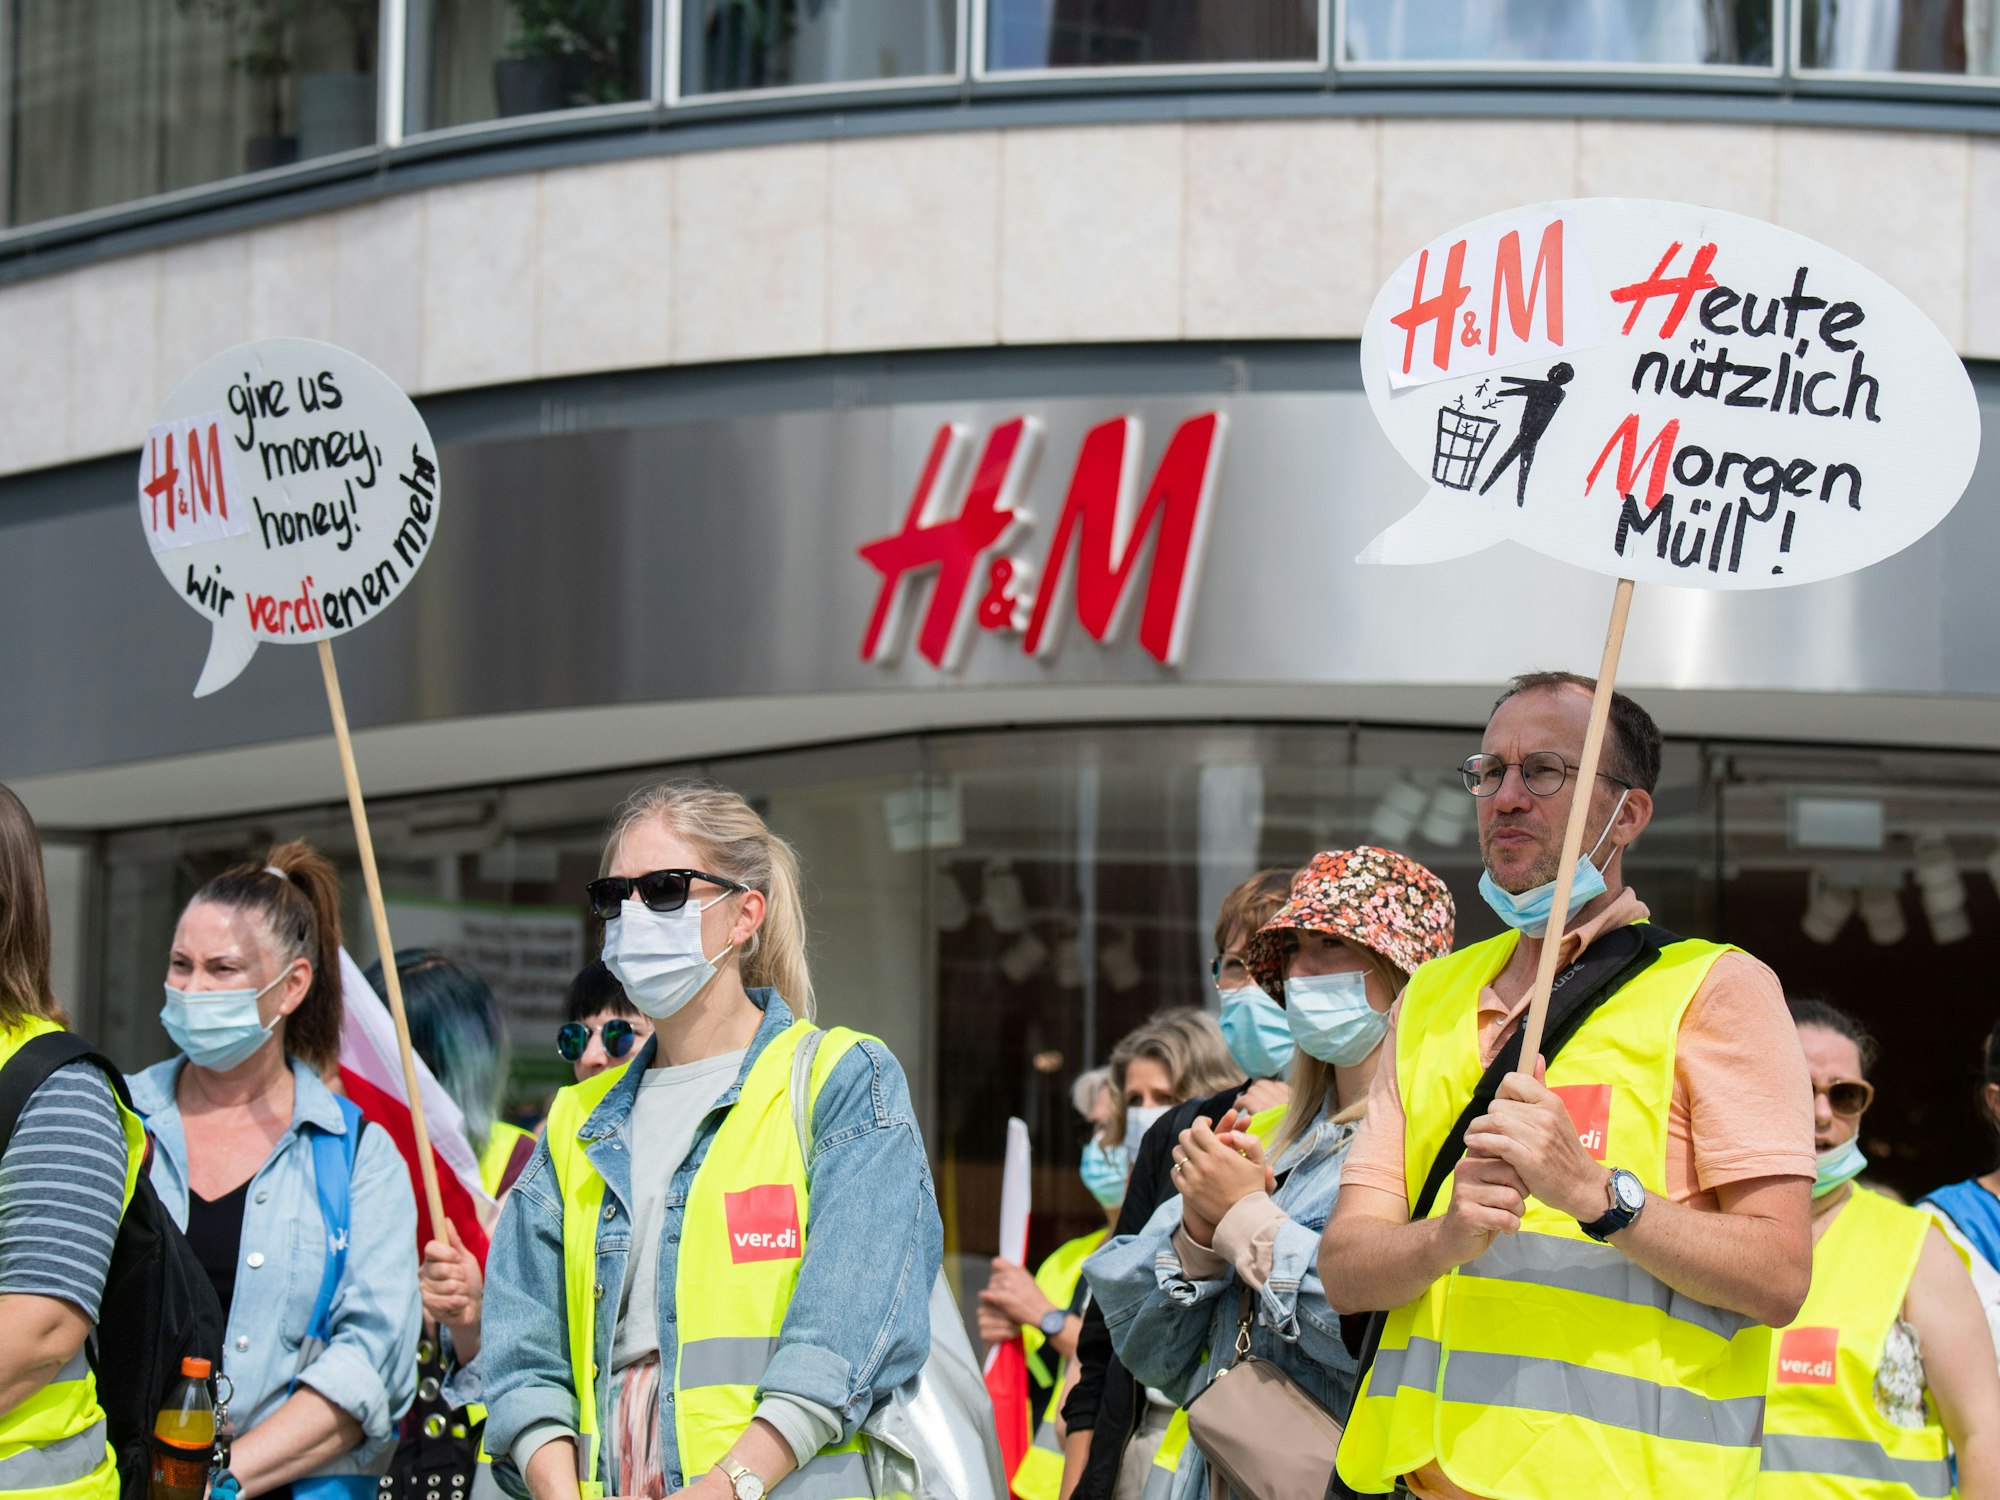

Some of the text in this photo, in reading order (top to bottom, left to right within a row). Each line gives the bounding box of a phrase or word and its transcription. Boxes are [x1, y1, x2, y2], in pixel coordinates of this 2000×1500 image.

[1390, 219, 1564, 374] H&M
[1611, 241, 1865, 352] Heute
[228, 371, 343, 452] give us
[1632, 338, 1880, 423] nützlich
[143, 422, 228, 532] H&M
[259, 430, 382, 489] money,
[1585, 413, 1862, 523] Morgen
[187, 564, 235, 617] wir
[393, 442, 436, 568] mehr
[252, 479, 361, 551] honey!
[857, 411, 1219, 670] H&M
[733, 1228, 797, 1249] ver.di
[1780, 1359, 1833, 1378] ver.di
